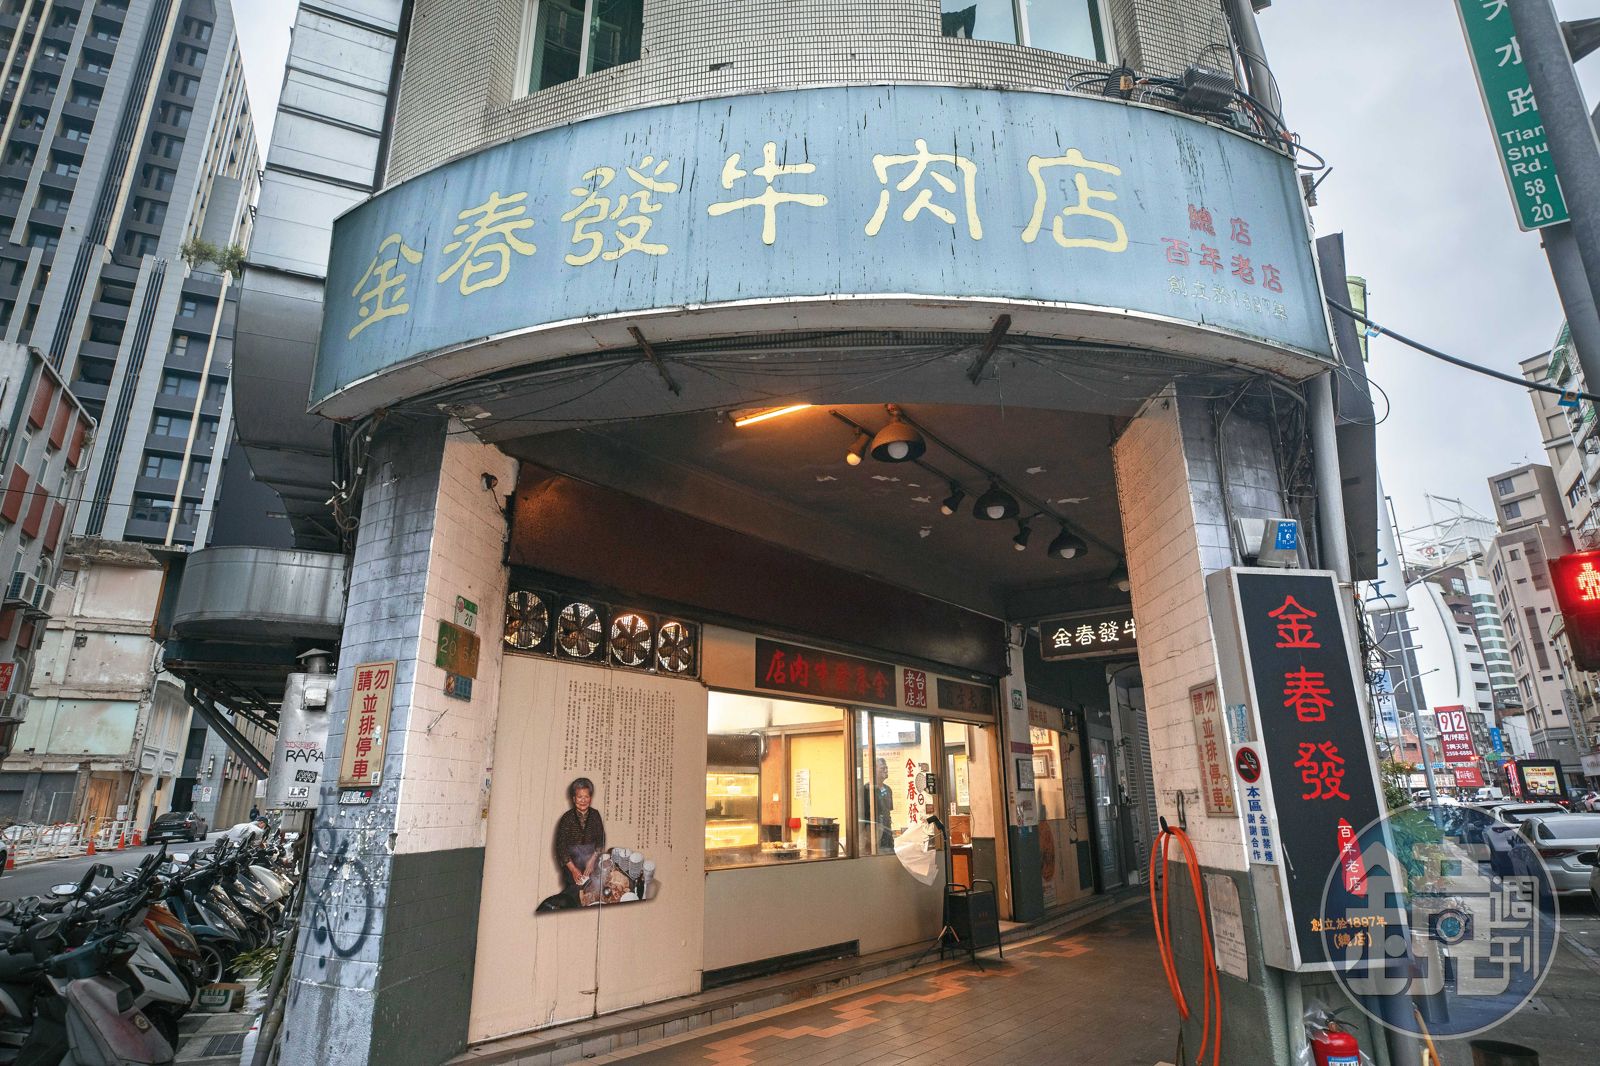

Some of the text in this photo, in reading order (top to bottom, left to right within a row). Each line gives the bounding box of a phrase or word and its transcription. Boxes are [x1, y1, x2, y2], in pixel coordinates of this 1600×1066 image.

[1502, 126, 1545, 145] Tian
[1507, 142, 1549, 162] Shu
[1512, 159, 1548, 178] Rd.
[349, 139, 1129, 341] 金春發牛肉店
[1161, 237, 1283, 294] 百年老店
[357, 669, 390, 692] 請勿
[1268, 595, 1351, 802] 金春發
[1440, 714, 1464, 732] 92
[905, 758, 919, 824] 金春發
[1246, 786, 1262, 812] 本區
[1247, 814, 1262, 861] 謝謝合作
[1259, 814, 1274, 862] 全面禁煙
[1337, 825, 1362, 892] 百年老店
